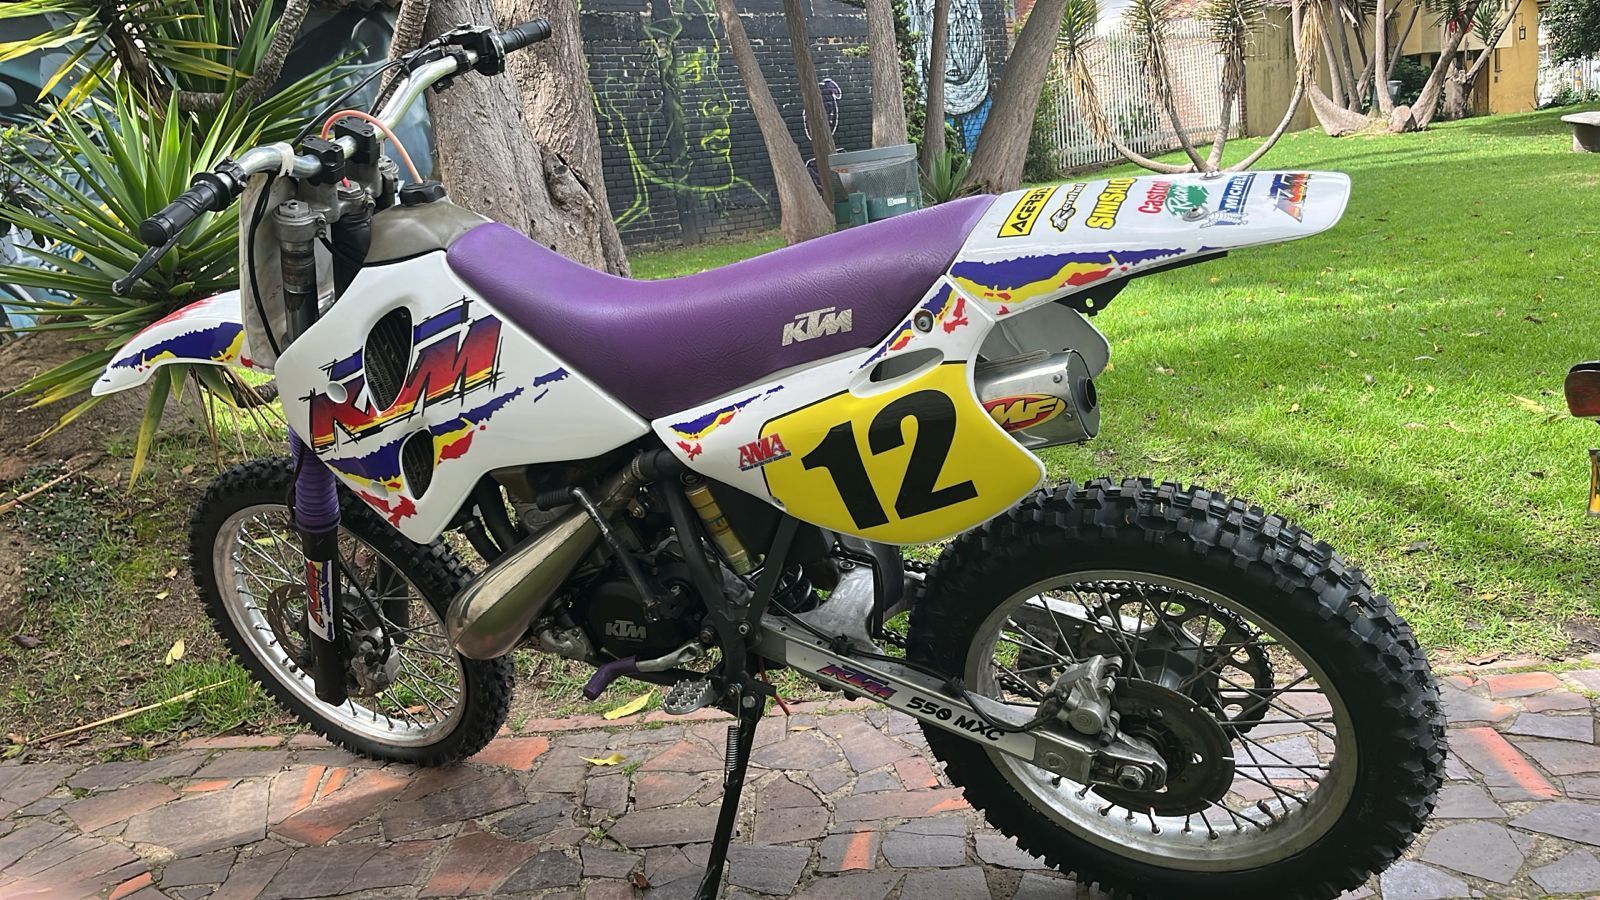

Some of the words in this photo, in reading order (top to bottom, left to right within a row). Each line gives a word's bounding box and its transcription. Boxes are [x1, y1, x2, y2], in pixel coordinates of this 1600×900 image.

[1085, 178, 1137, 230] SINISALO
[1224, 174, 1248, 209] MICHEL
[782, 306, 853, 346] KTM
[737, 433, 790, 469] AMA
[801, 389, 979, 530] 12
[605, 619, 647, 639] KTM
[816, 662, 898, 700] KTM
[906, 696, 952, 721] 550
[953, 714, 1005, 741] MXC
